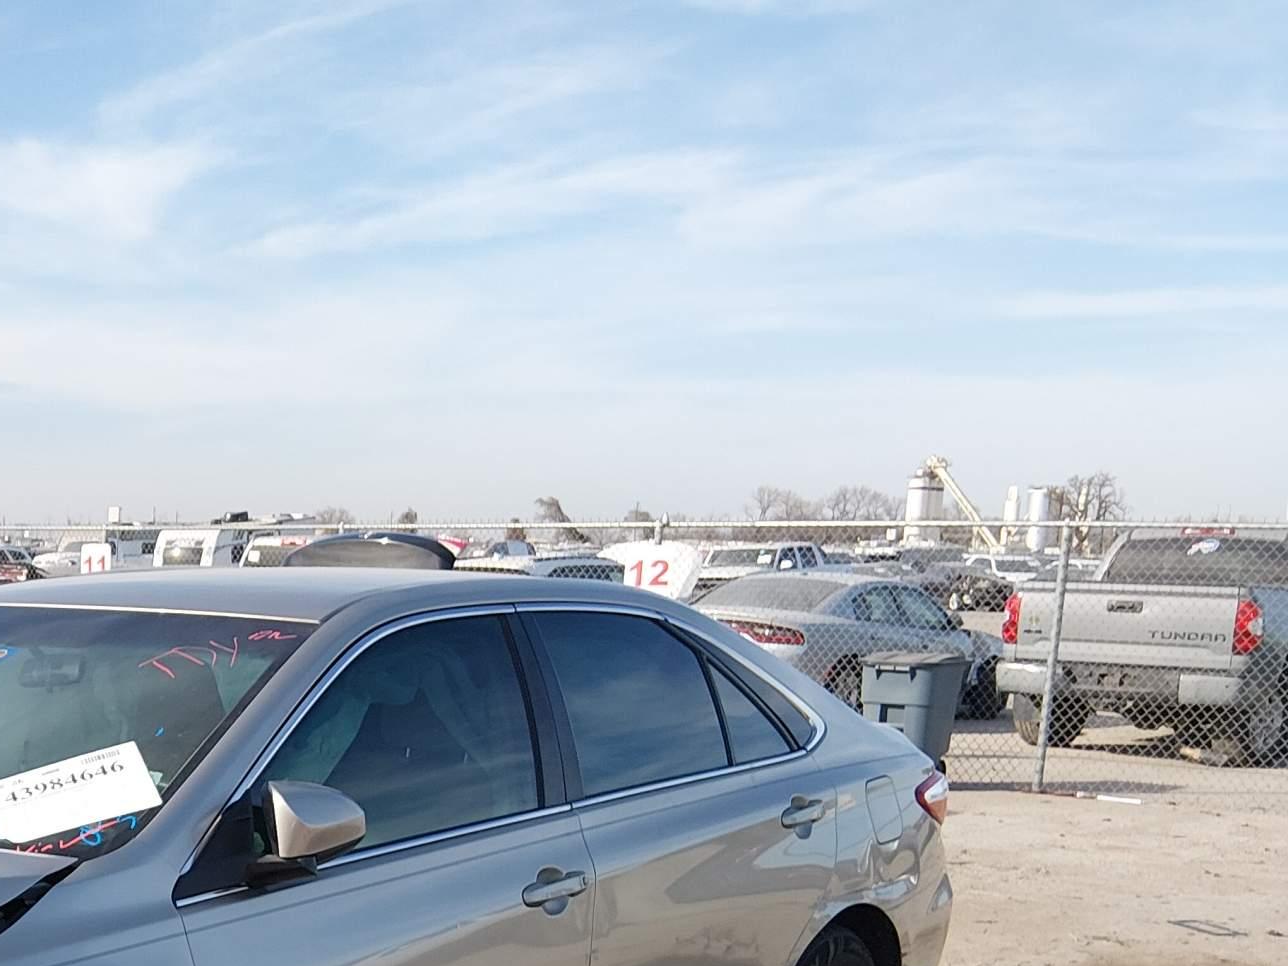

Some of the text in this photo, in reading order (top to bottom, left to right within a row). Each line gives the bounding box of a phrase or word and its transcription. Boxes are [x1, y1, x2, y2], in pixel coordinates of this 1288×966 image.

[83, 555, 105, 576] 11
[629, 559, 669, 588] 12
[1147, 629, 1227, 643] TUNDRA
[5, 760, 124, 802] 43984646
